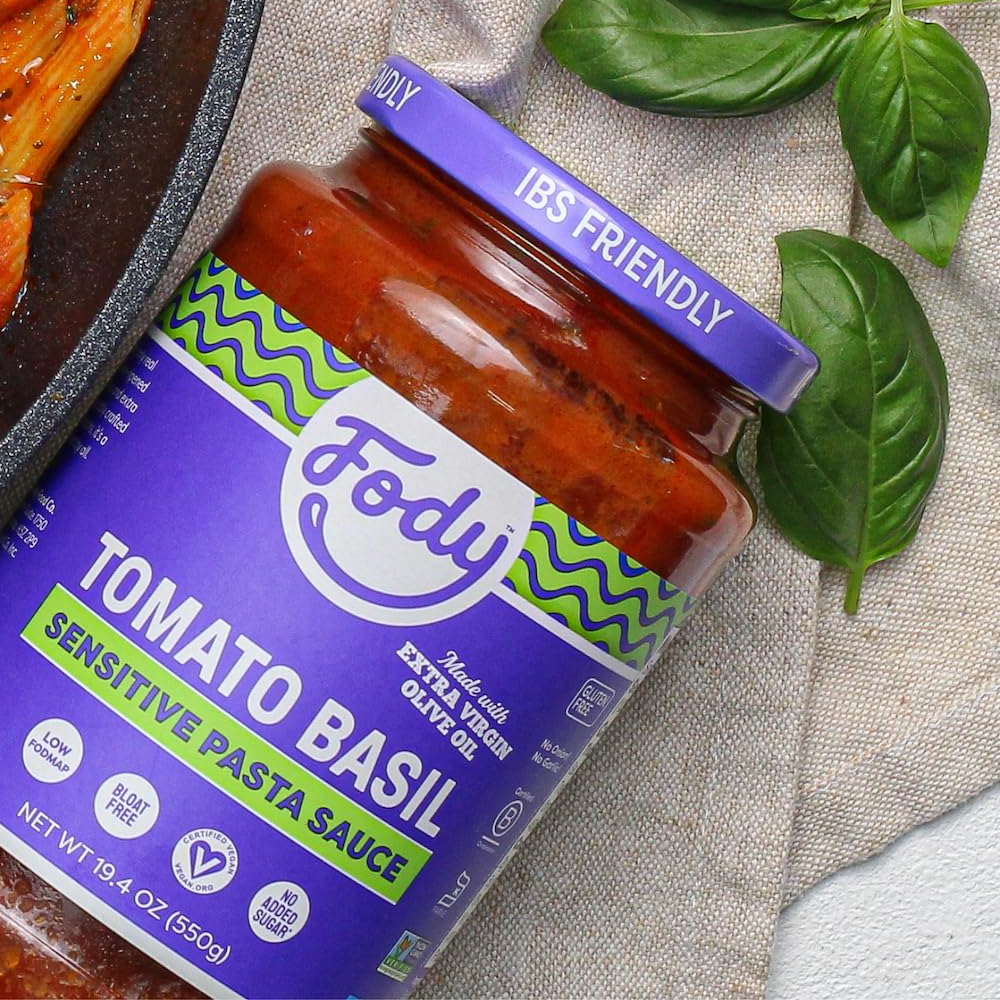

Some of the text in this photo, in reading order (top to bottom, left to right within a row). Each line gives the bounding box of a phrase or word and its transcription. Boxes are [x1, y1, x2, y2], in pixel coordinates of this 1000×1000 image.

[514, 167, 735, 335] IBS FRIENDLY
[301, 415, 509, 608] Fody
[79, 530, 457, 838] TOMATO BASIL
[396, 640, 514, 761] EXTRA VIRGIN
[436, 650, 510, 725] Made with
[571, 697, 595, 717] FREE
[400, 679, 479, 762] OLIVE OIL
[28, 738, 70, 774] FODMAP
[42, 731, 73, 757] LOW
[44, 611, 409, 884] SENSITIVE PASTA SAUCE
[105, 797, 139, 828] FREE
[112, 782, 152, 816] BLOAT
[182, 829, 237, 875] CERTIFIED VEGAN
[17, 800, 231, 966] NET WT 19.4 OZ (550g)
[174, 862, 215, 892] VEGAN.ORG
[279, 888, 299, 907] NO
[261, 896, 299, 926] ADDED
